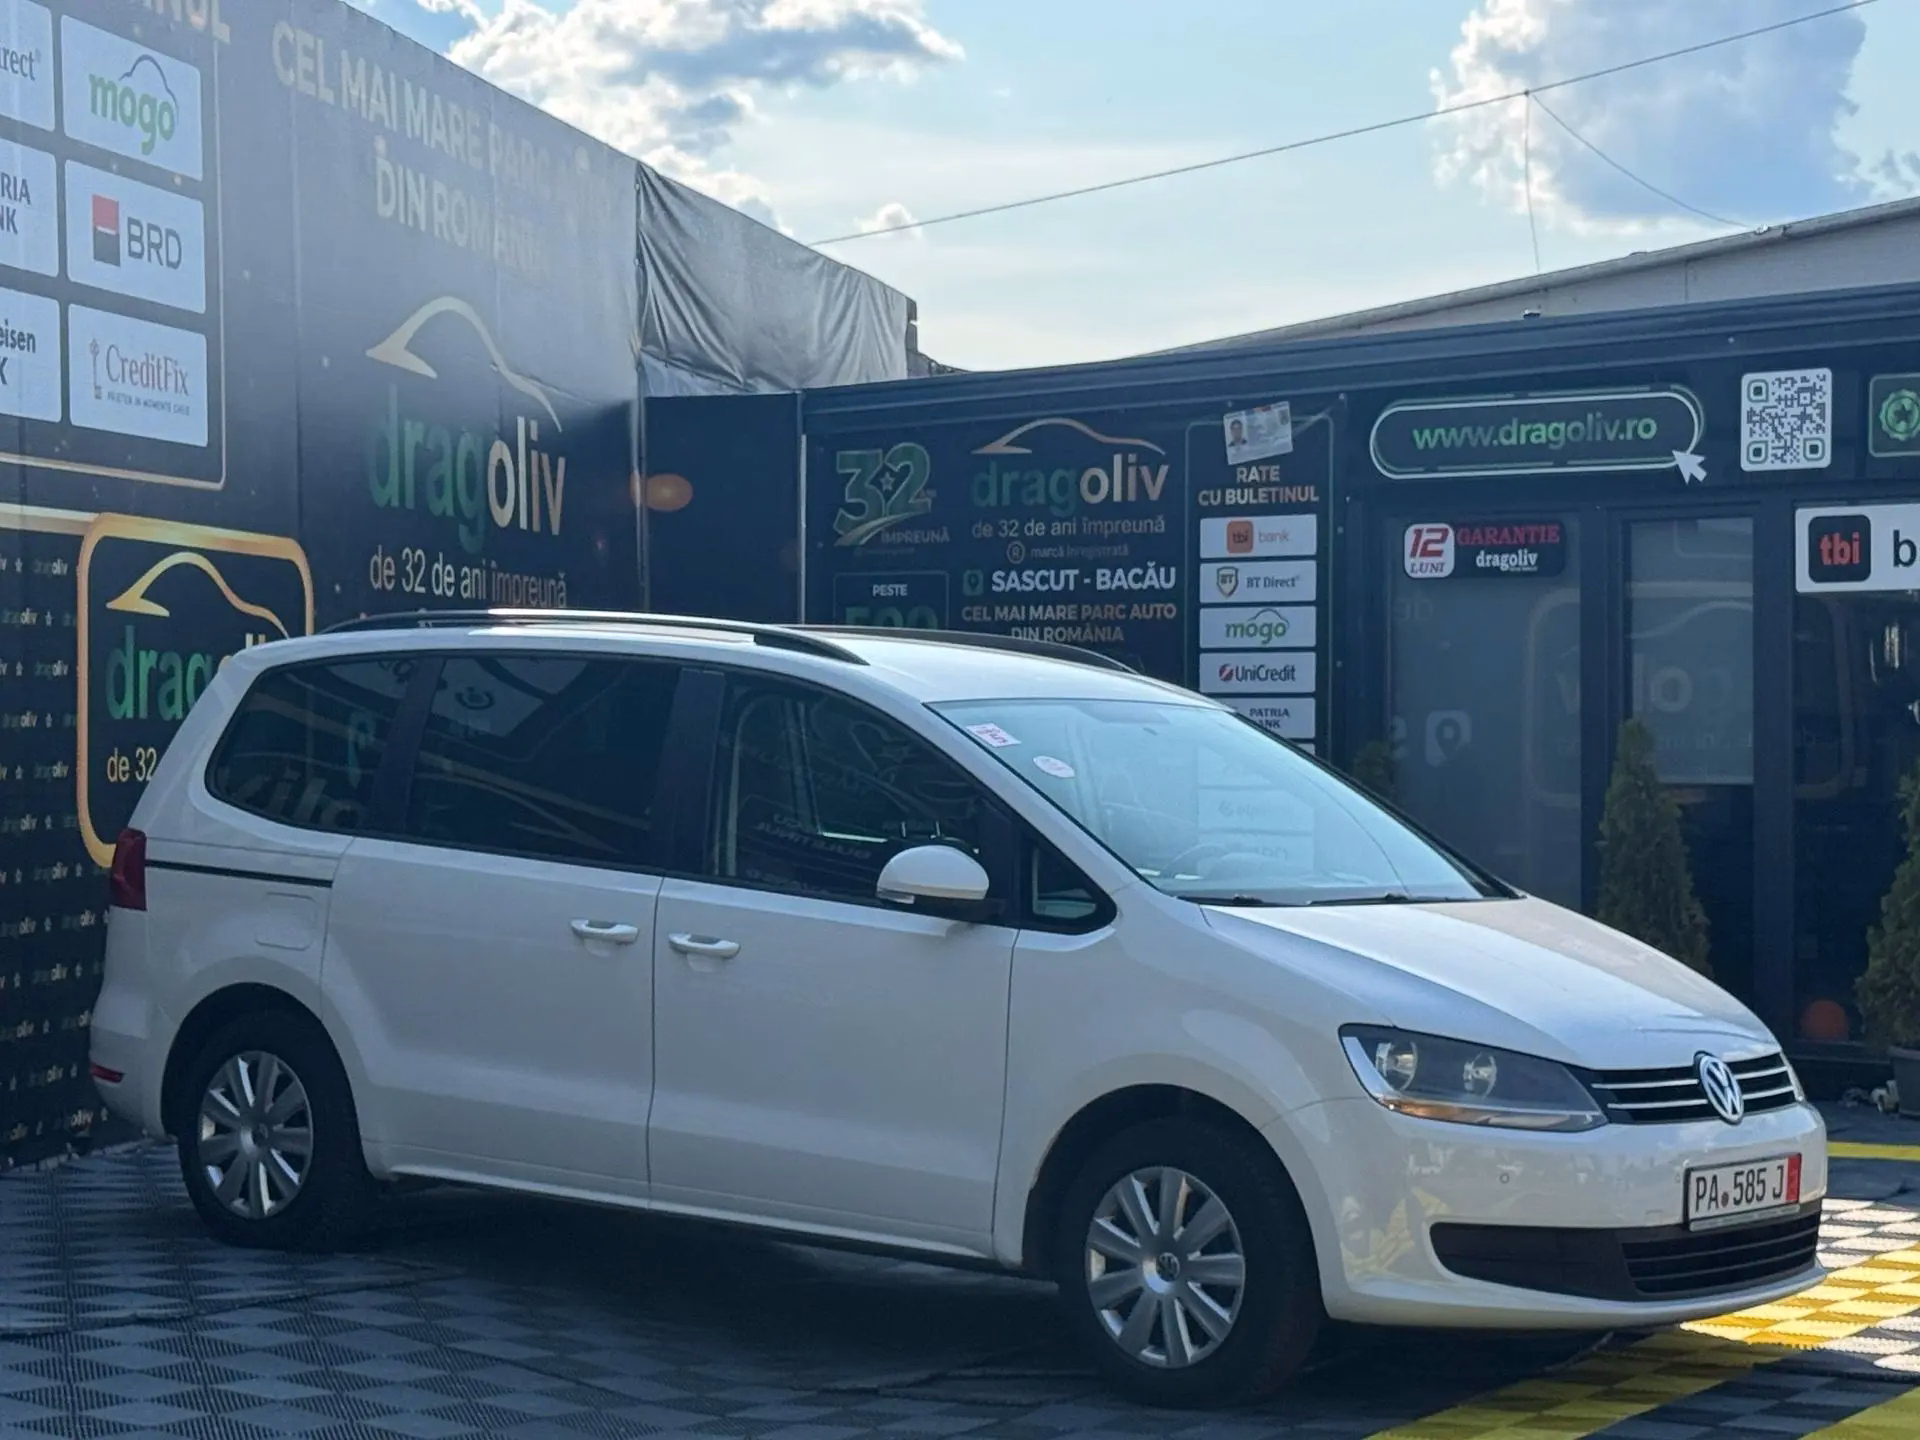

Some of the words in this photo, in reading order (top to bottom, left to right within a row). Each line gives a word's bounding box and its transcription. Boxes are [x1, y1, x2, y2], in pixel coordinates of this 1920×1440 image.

[0, 46, 36, 81] rect
[271, 21, 335, 106] CEL
[340, 49, 398, 132] MAI
[404, 78, 484, 170] MARE
[88, 73, 175, 155] mogo
[375, 156, 426, 232] DIN
[127, 216, 182, 269] BRD
[105, 344, 189, 396] CreditFix
[1412, 412, 1658, 450] www.dragoliv.ro
[368, 382, 566, 554] dragoliv
[1236, 465, 1280, 483] RATE
[833, 442, 930, 544] 32
[971, 453, 1170, 517] dragoliv
[1198, 489, 1221, 505] CU
[1225, 485, 1319, 505] BULETINUL
[972, 519, 993, 538] de
[998, 518, 1019, 538] 32
[1024, 518, 1045, 537] de
[1050, 517, 1076, 535] ani
[1082, 516, 1165, 538] împreună
[1232, 530, 1249, 544] tbi
[1258, 531, 1289, 543] bank
[1456, 524, 1560, 546] GARANTIE
[1409, 528, 1449, 558] 12
[1819, 532, 1860, 566] tbi
[370, 544, 396, 591] de
[401, 547, 427, 594] 32
[431, 551, 455, 598] de
[460, 558, 486, 600] ani
[1410, 562, 1445, 574] LUNI
[1476, 549, 1538, 571] dragoliv
[872, 584, 908, 597] PESTE
[991, 568, 1080, 592] SASCUT
[1096, 562, 1176, 590] BACĂU
[1246, 577, 1261, 588] BT
[1264, 575, 1297, 588] Direct
[961, 606, 991, 622] CEL
[995, 605, 1025, 621] MAI
[1029, 604, 1077, 621] MARE
[1081, 603, 1126, 620] PARC
[1130, 603, 1177, 619] AUTO
[1011, 626, 1039, 641] DIN
[1044, 625, 1124, 643] ROMÂNIA
[1225, 622, 1287, 645] mogo
[1235, 664, 1297, 683] UniCredit
[1249, 708, 1290, 719] PATRIA
[107, 747, 130, 783] de
[135, 747, 157, 783] 32
[1695, 1173, 1720, 1213] PA
[1733, 1167, 1767, 1206] 585
[1773, 1165, 1785, 1199] J
